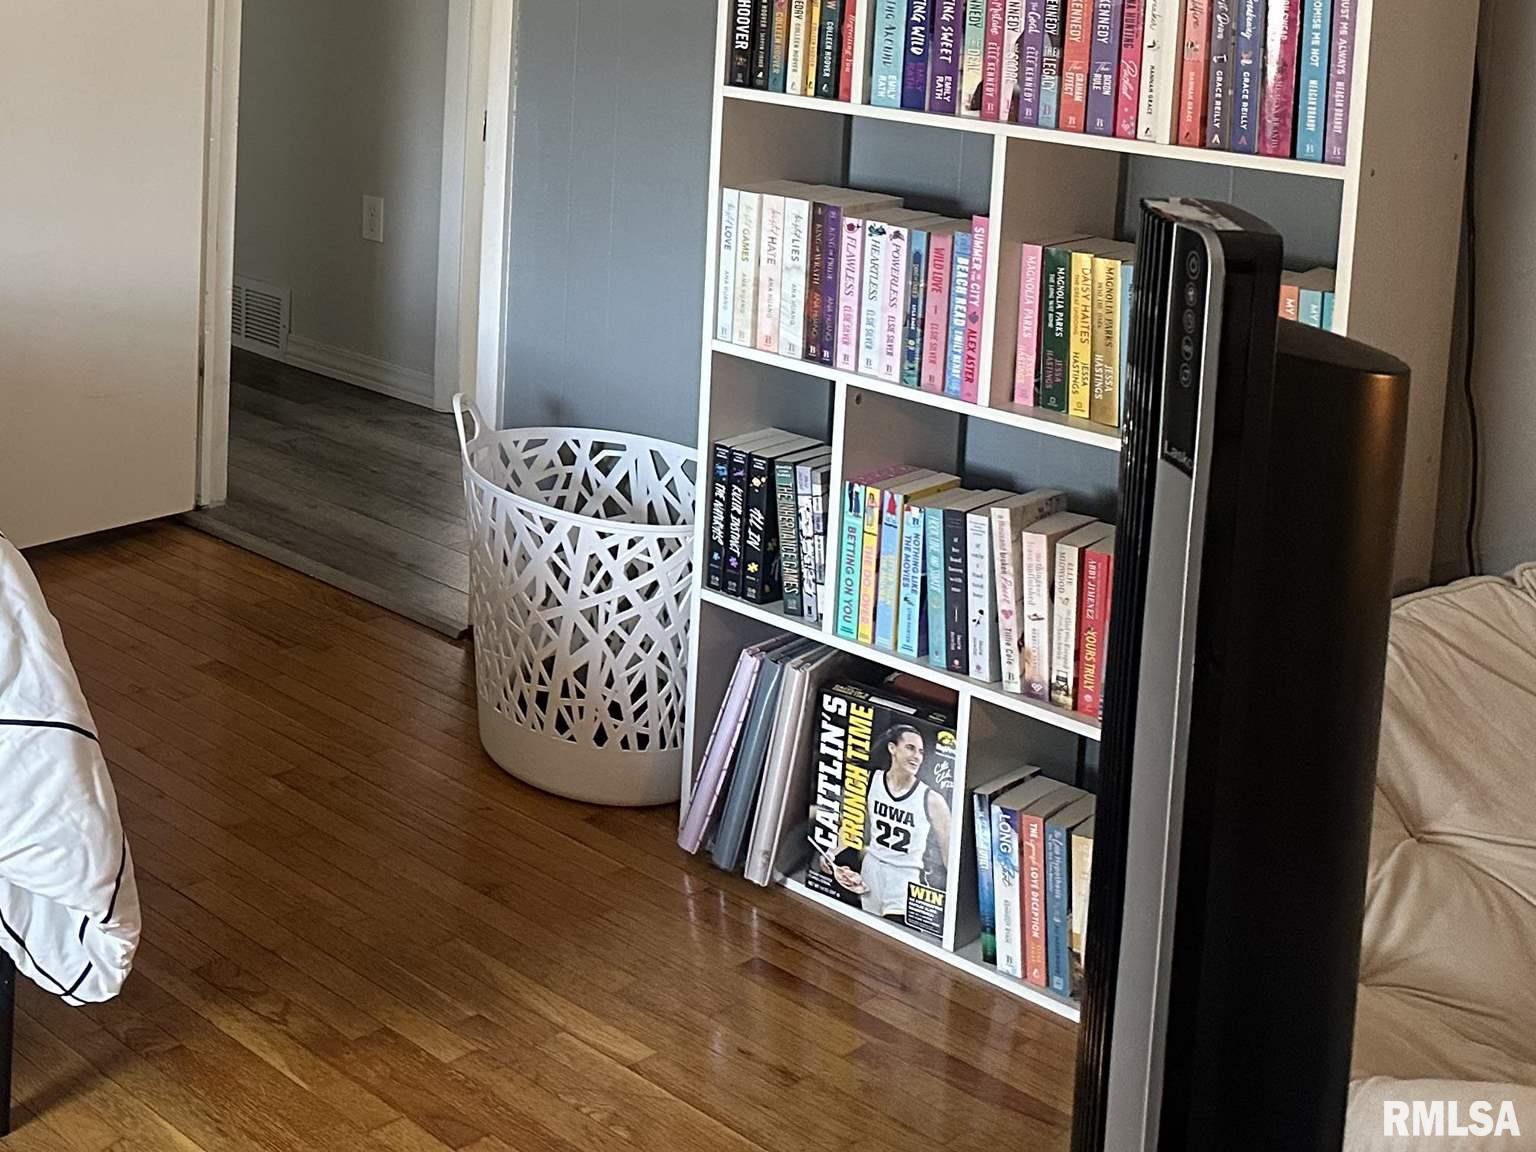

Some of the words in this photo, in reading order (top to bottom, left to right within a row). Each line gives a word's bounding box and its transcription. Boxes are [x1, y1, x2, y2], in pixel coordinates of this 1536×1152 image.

[735, 0, 751, 49] HOOVER
[1312, 32, 1321, 45] ME
[911, 26, 925, 55] WILD
[940, 26, 955, 63] SWEET
[988, 42, 998, 59] ELLE
[1026, 47, 1036, 64] ELLE
[1310, 48, 1320, 67] NOT
[878, 75, 886, 97] RATH
[887, 75, 897, 99] EMILY
[935, 76, 943, 100] RATH
[944, 76, 952, 102] EMILY
[986, 62, 997, 96] KENNEDY
[1024, 66, 1035, 102] KENNEDY
[1042, 57, 1056, 92] LEGACY
[1065, 72, 1074, 96] EFFECT
[1074, 73, 1084, 101] GRAHAM
[1093, 74, 1102, 90] RULE
[1102, 74, 1112, 95] DIXON
[1215, 70, 1223, 98] GRACE
[1242, 72, 1250, 99] GRACE
[1214, 101, 1222, 128] REILLY
[1240, 102, 1248, 129] REILLY
[724, 226, 734, 251] LOVE
[741, 228, 750, 262] GAMES
[767, 236, 777, 265] HATE
[791, 239, 800, 262] LIES
[972, 227, 984, 270] SUMMER
[844, 235, 857, 296] FLAWLESS
[868, 238, 880, 301] HEARTLESS
[933, 248, 945, 269] WILD
[889, 242, 901, 309] POWERLESS
[931, 271, 943, 294] LOVE
[956, 257, 968, 293] BEACH
[1024, 255, 1036, 305] MAGNOLIA
[1056, 267, 1065, 309] MAGNOLIA
[1081, 268, 1091, 301] DAISY
[969, 283, 980, 307] CITY
[1104, 266, 1114, 316] MAGNOLIA
[954, 297, 966, 326] READ
[1285, 298, 1295, 316] MY
[1309, 303, 1319, 321] MY
[1022, 308, 1033, 338] PARKS
[1055, 312, 1063, 337] PARKS
[1080, 304, 1089, 344] HAITES
[1104, 319, 1113, 348] PARKS
[967, 328, 977, 352] ALEX
[964, 354, 976, 383] ASTER
[1081, 362, 1089, 386] JESSA
[1094, 354, 1104, 399] HASTINGS
[1104, 364, 1113, 392] JESSA
[845, 526, 857, 575] BETTING
[911, 533, 921, 574] NOTHING
[902, 553, 910, 588] MOVIES
[1088, 559, 1096, 579] ABBY
[845, 578, 855, 597] ON
[1086, 582, 1096, 620] JIMENEZ
[843, 599, 853, 623] YOU
[1084, 629, 1096, 661] YOURS
[1083, 663, 1095, 692] TRULY
[847, 702, 875, 762] TIME
[814, 694, 847, 850] CAITLIN'S
[842, 763, 870, 850] CRUNCH
[873, 800, 915, 827] IOWA
[876, 819, 911, 854] 22
[1030, 867, 1040, 888] LOVE
[909, 884, 944, 906] WIN
[1031, 892, 1040, 938] DECEPTION
